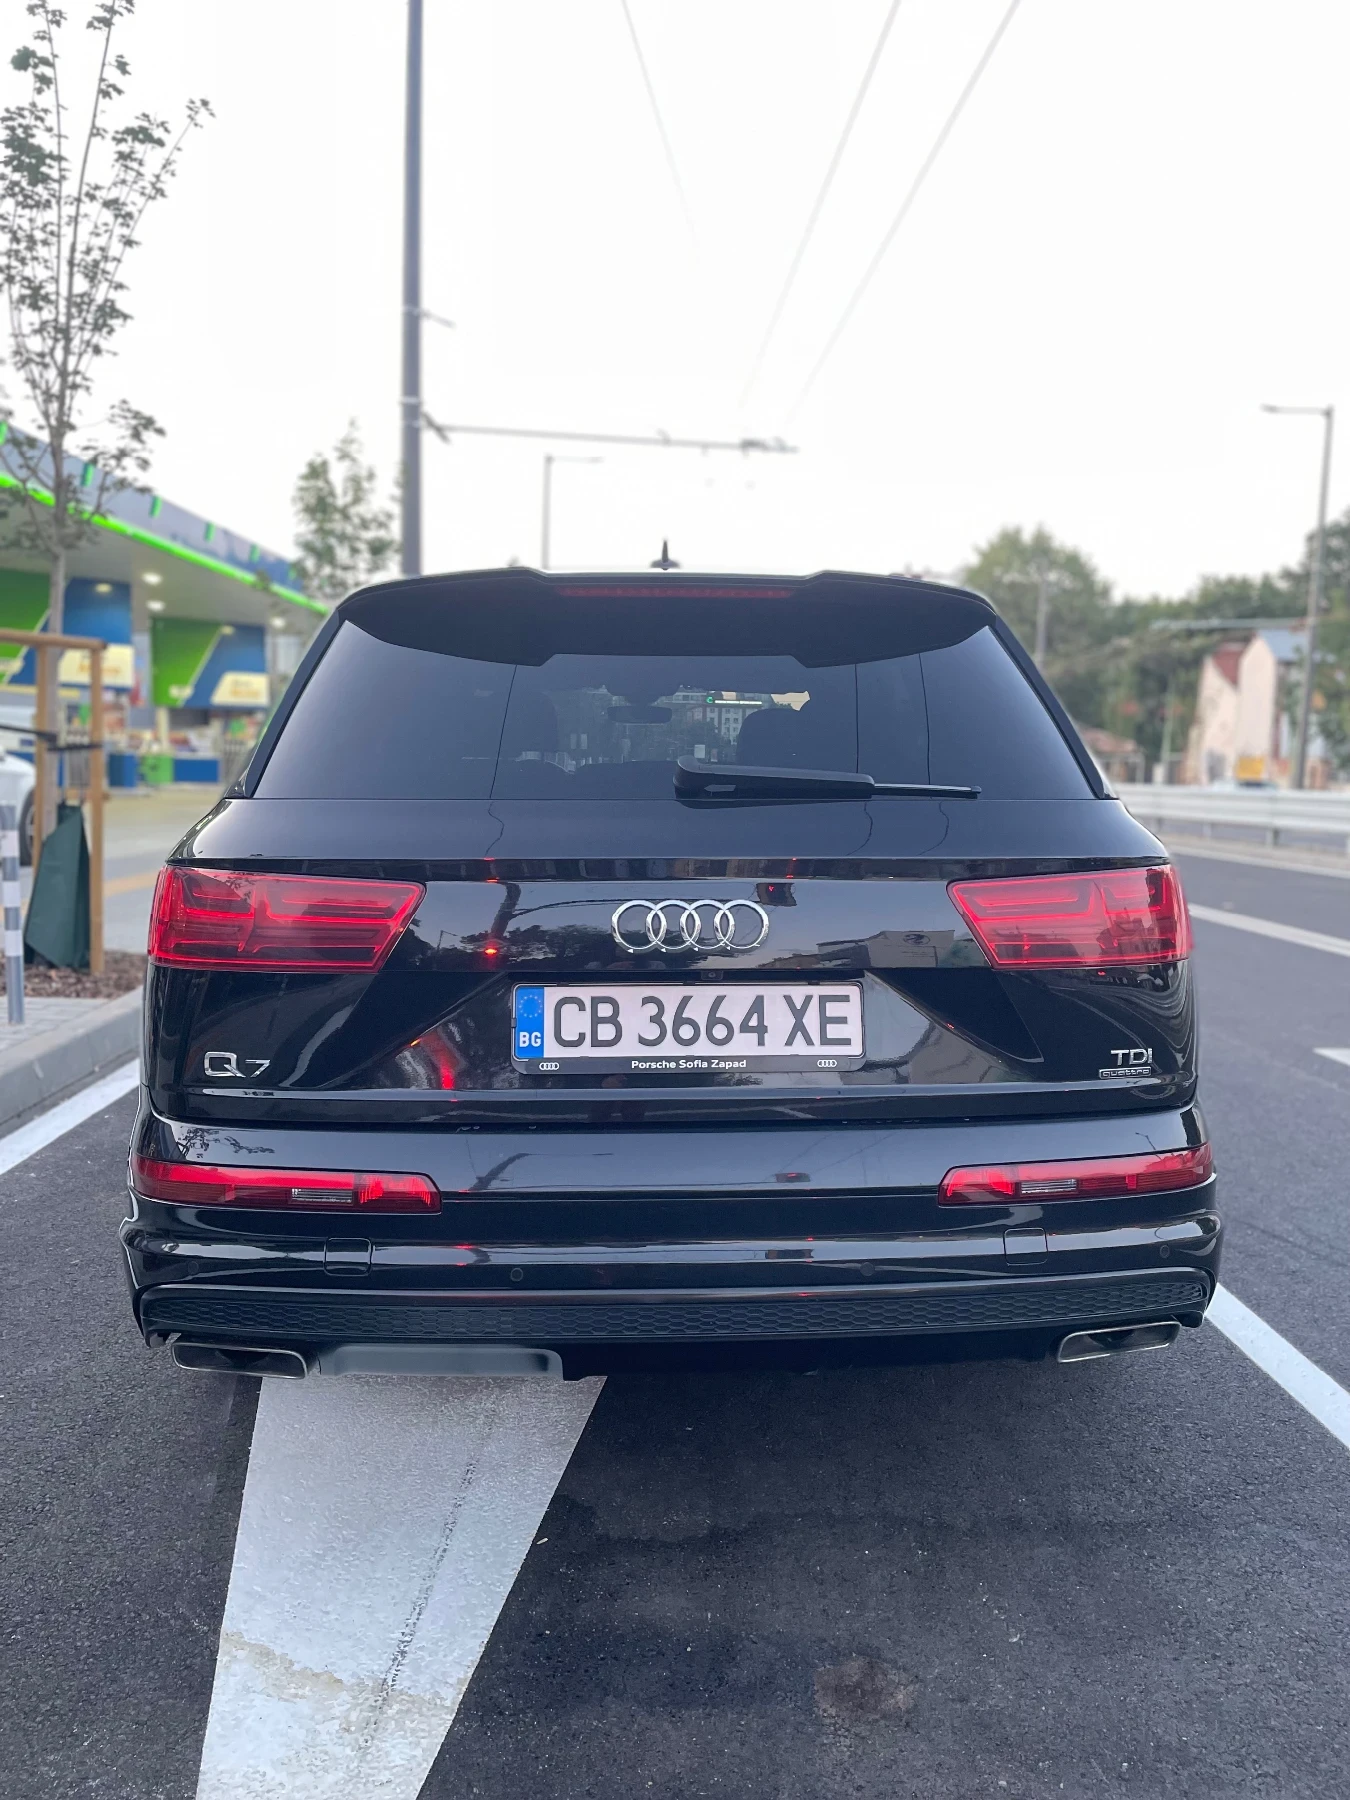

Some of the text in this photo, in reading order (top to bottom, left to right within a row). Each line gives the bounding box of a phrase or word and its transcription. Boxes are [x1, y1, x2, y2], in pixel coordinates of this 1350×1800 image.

[553, 994, 852, 1048] CB 3664 XE
[519, 1031, 542, 1048] BG
[203, 1051, 271, 1078] Q7
[631, 1059, 747, 1070] Porsche Sofia Zapad
[1110, 1047, 1153, 1066] TDI
[1102, 1068, 1150, 1078] quattro
